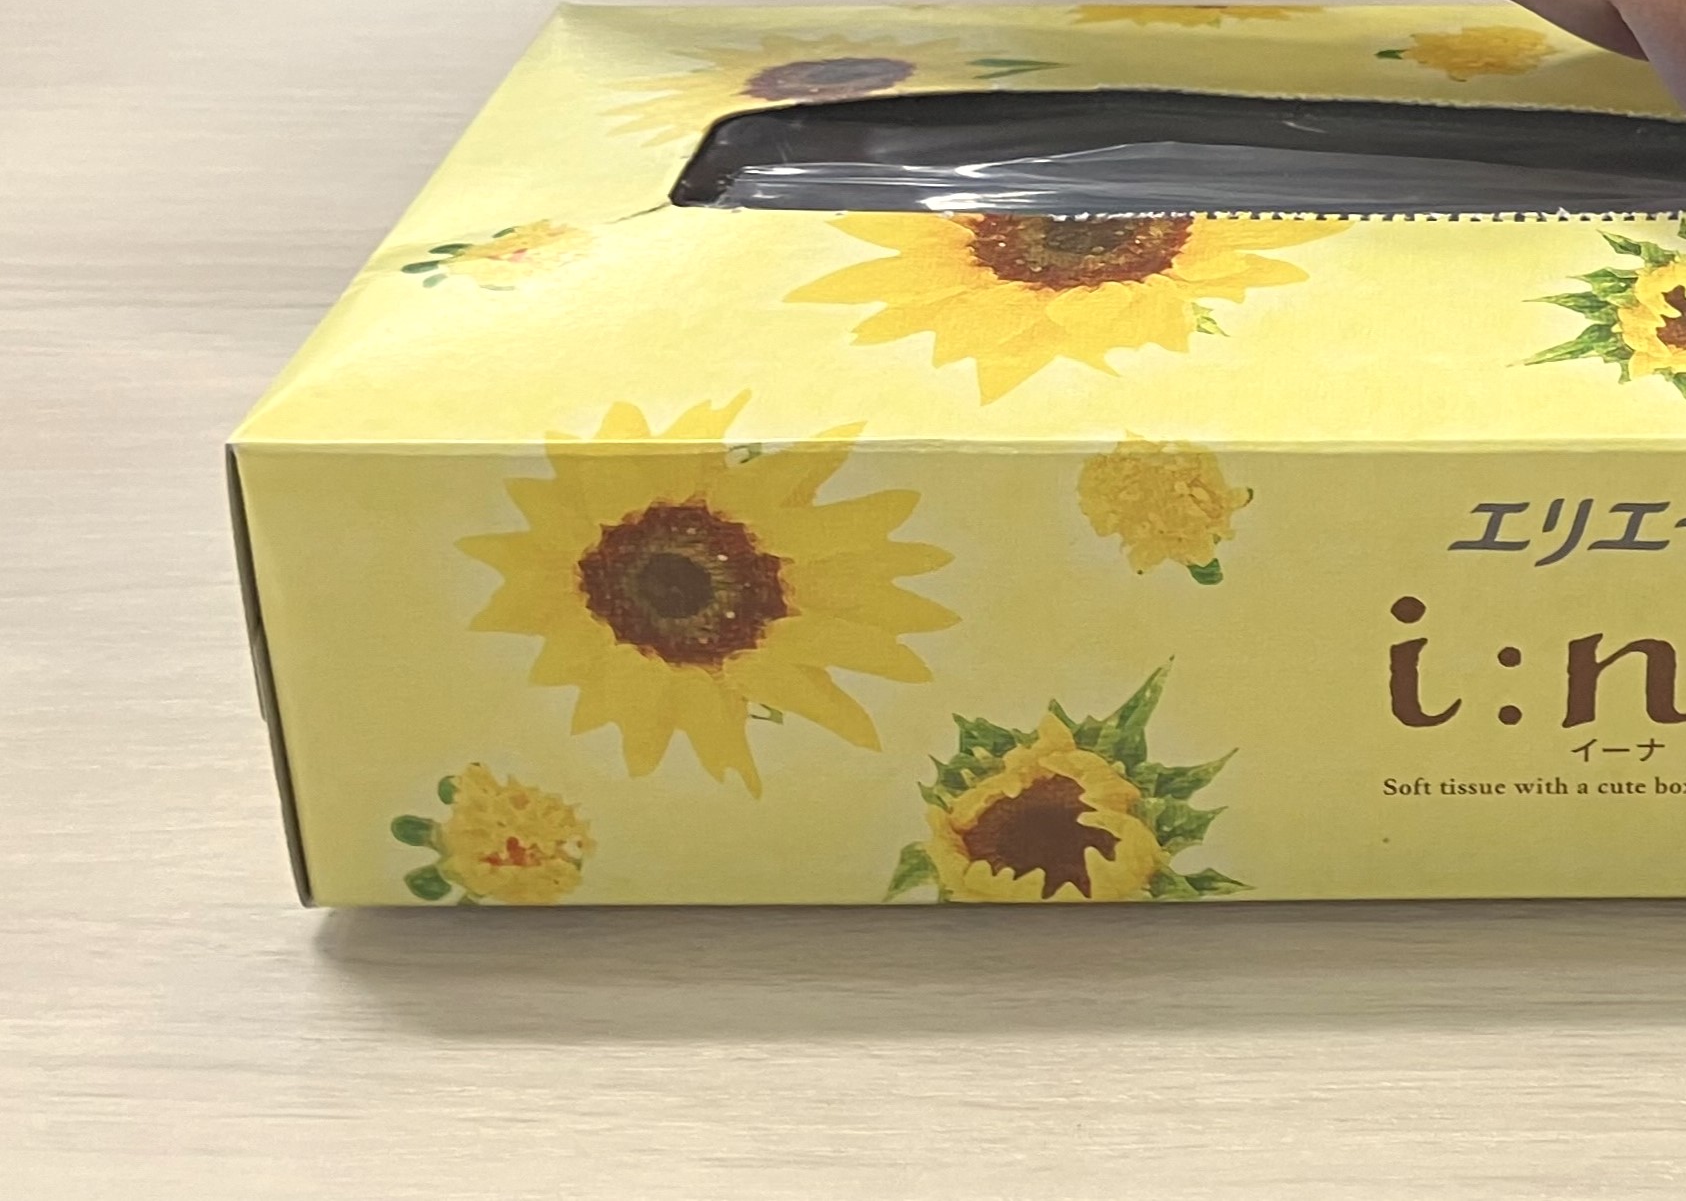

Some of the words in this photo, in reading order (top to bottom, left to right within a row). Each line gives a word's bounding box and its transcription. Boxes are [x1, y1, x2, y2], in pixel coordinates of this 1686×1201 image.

[1570, 737, 1666, 763] イーナ
[1383, 776, 1432, 796] Soft
[1439, 777, 1506, 796] tissue
[1513, 776, 1569, 796] with
[1576, 782, 1589, 796] a
[1597, 779, 1647, 796] cute
